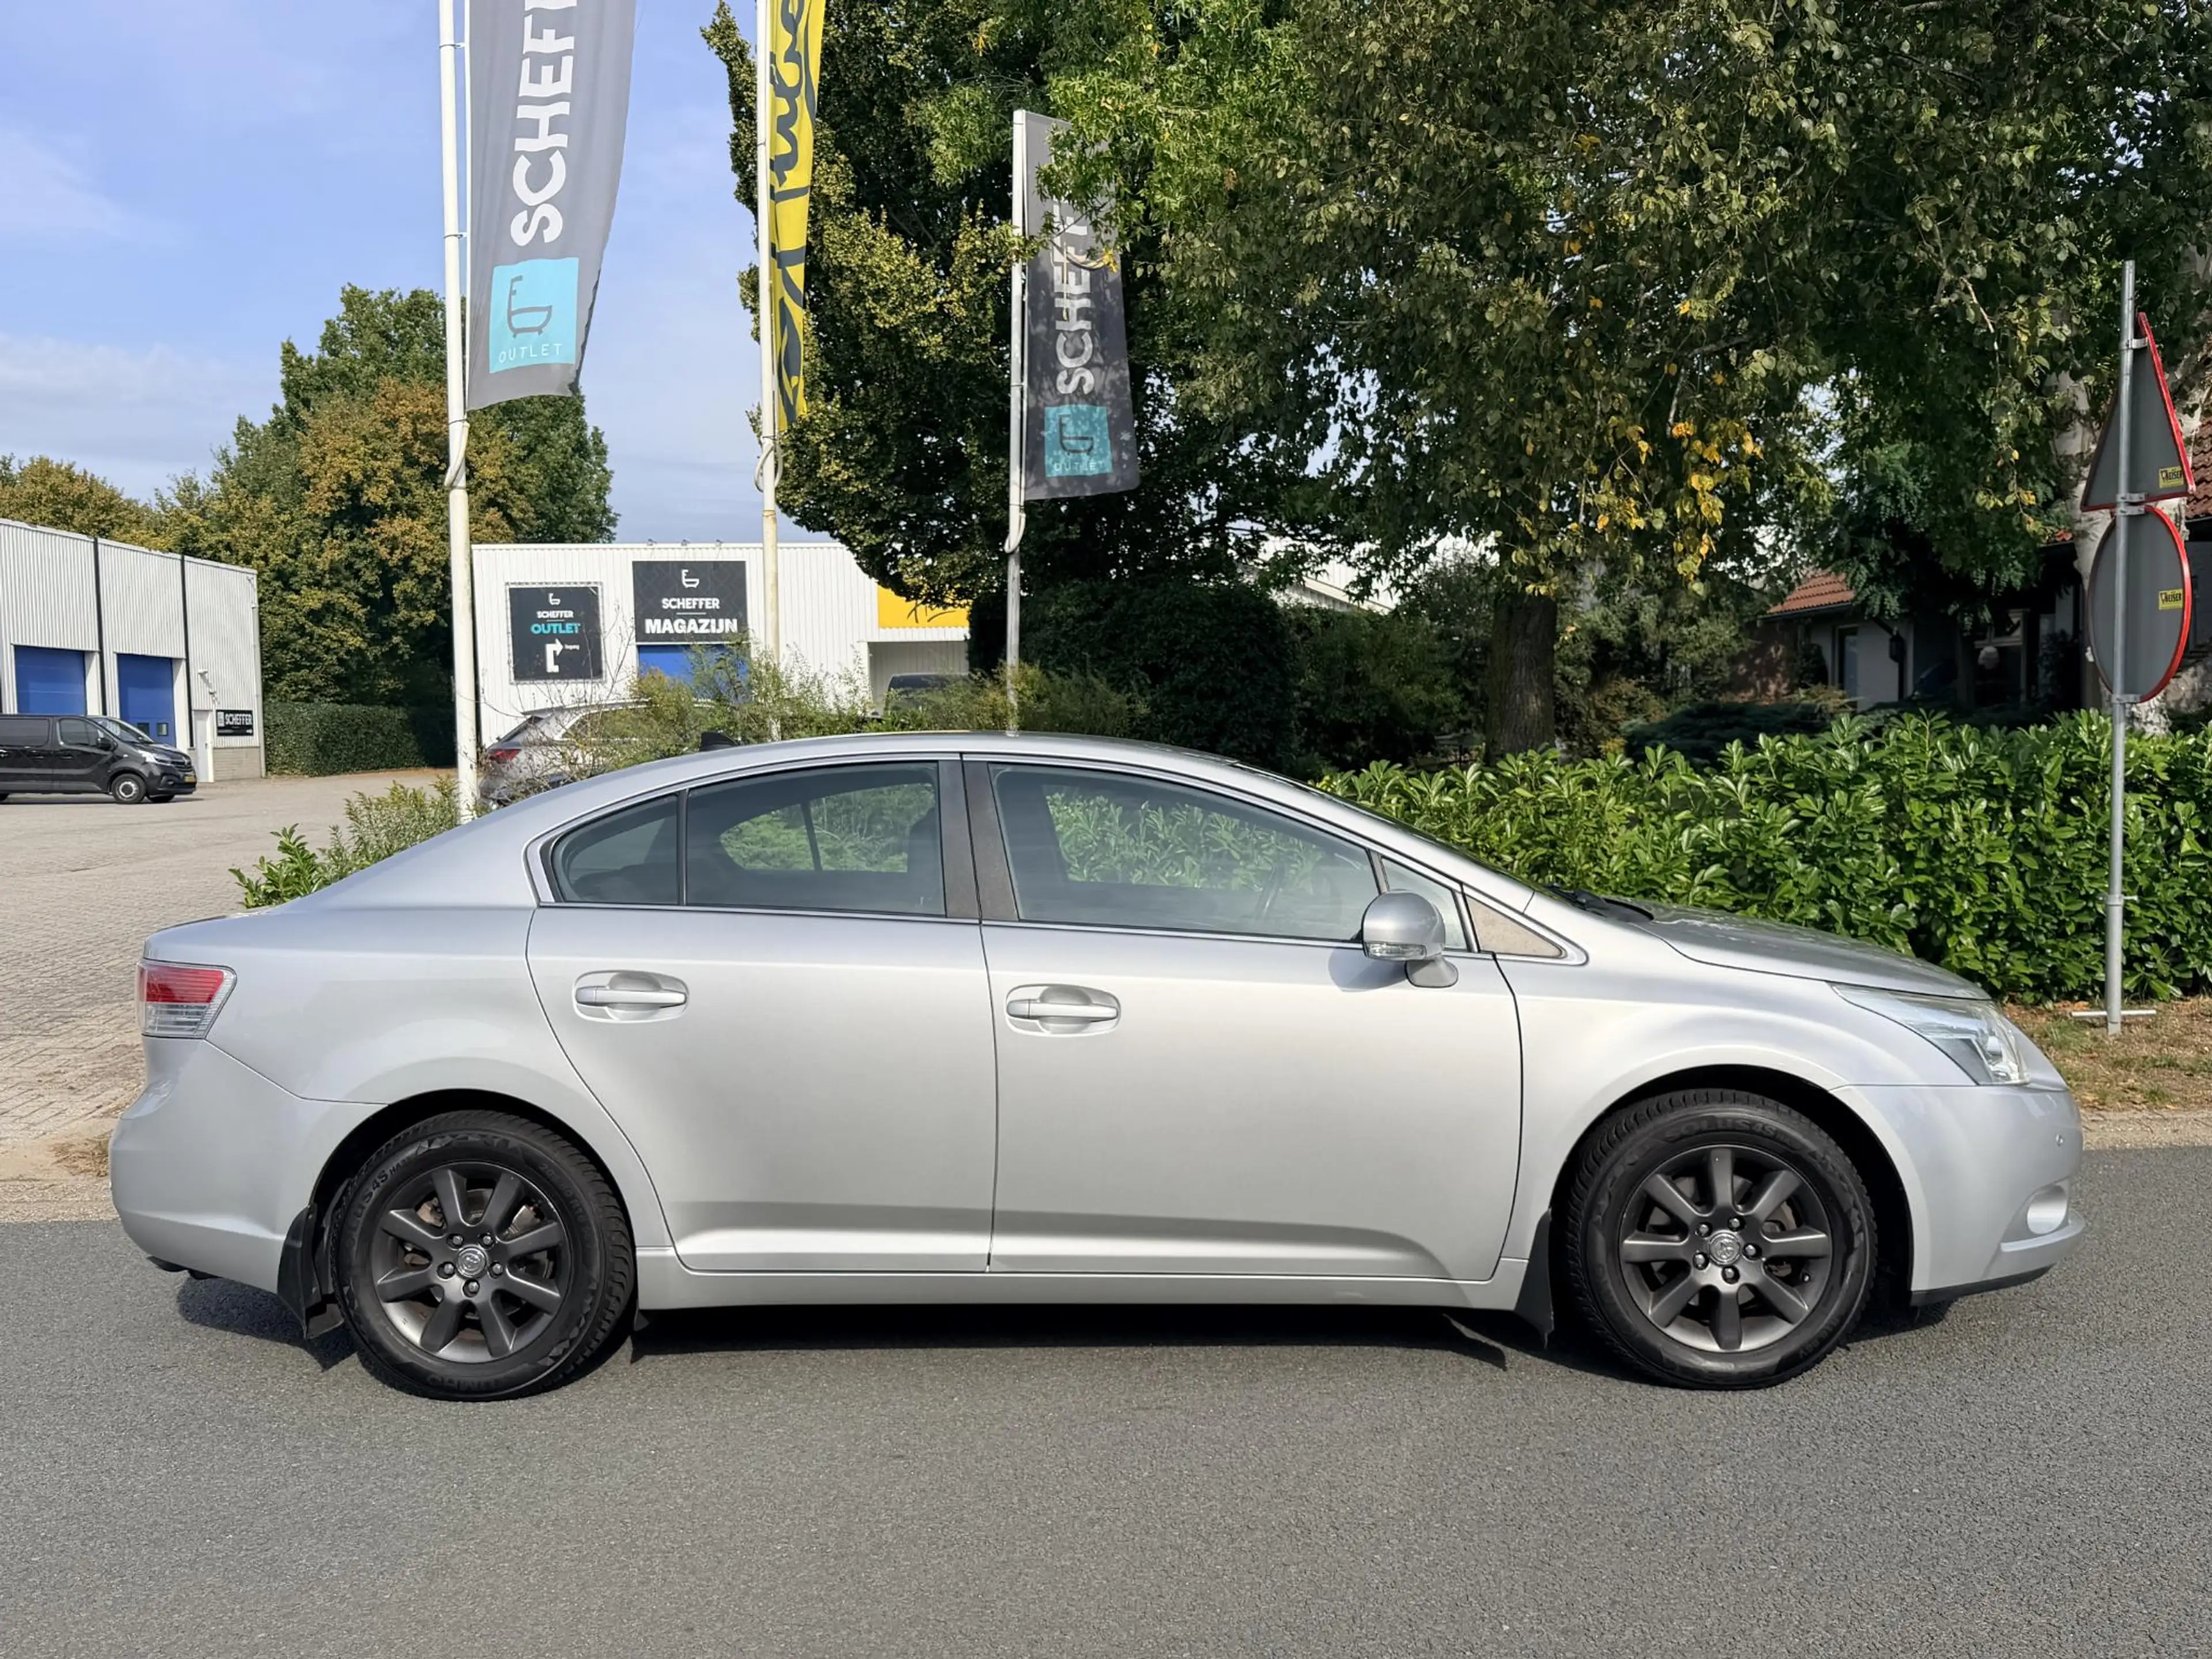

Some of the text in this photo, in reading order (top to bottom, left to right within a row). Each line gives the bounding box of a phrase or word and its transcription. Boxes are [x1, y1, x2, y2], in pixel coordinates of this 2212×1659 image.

[510, 0, 577, 247] SCHEF
[498, 343, 563, 363] OUTLET
[1054, 461, 1105, 471] OUTLET
[662, 597, 720, 609] SCHEFFER
[536, 610, 574, 619] SCHEFFER
[531, 623, 581, 634] OUTLET
[645, 618, 738, 634] MAGAZIJN
[225, 714, 252, 725] SCHEFFER
